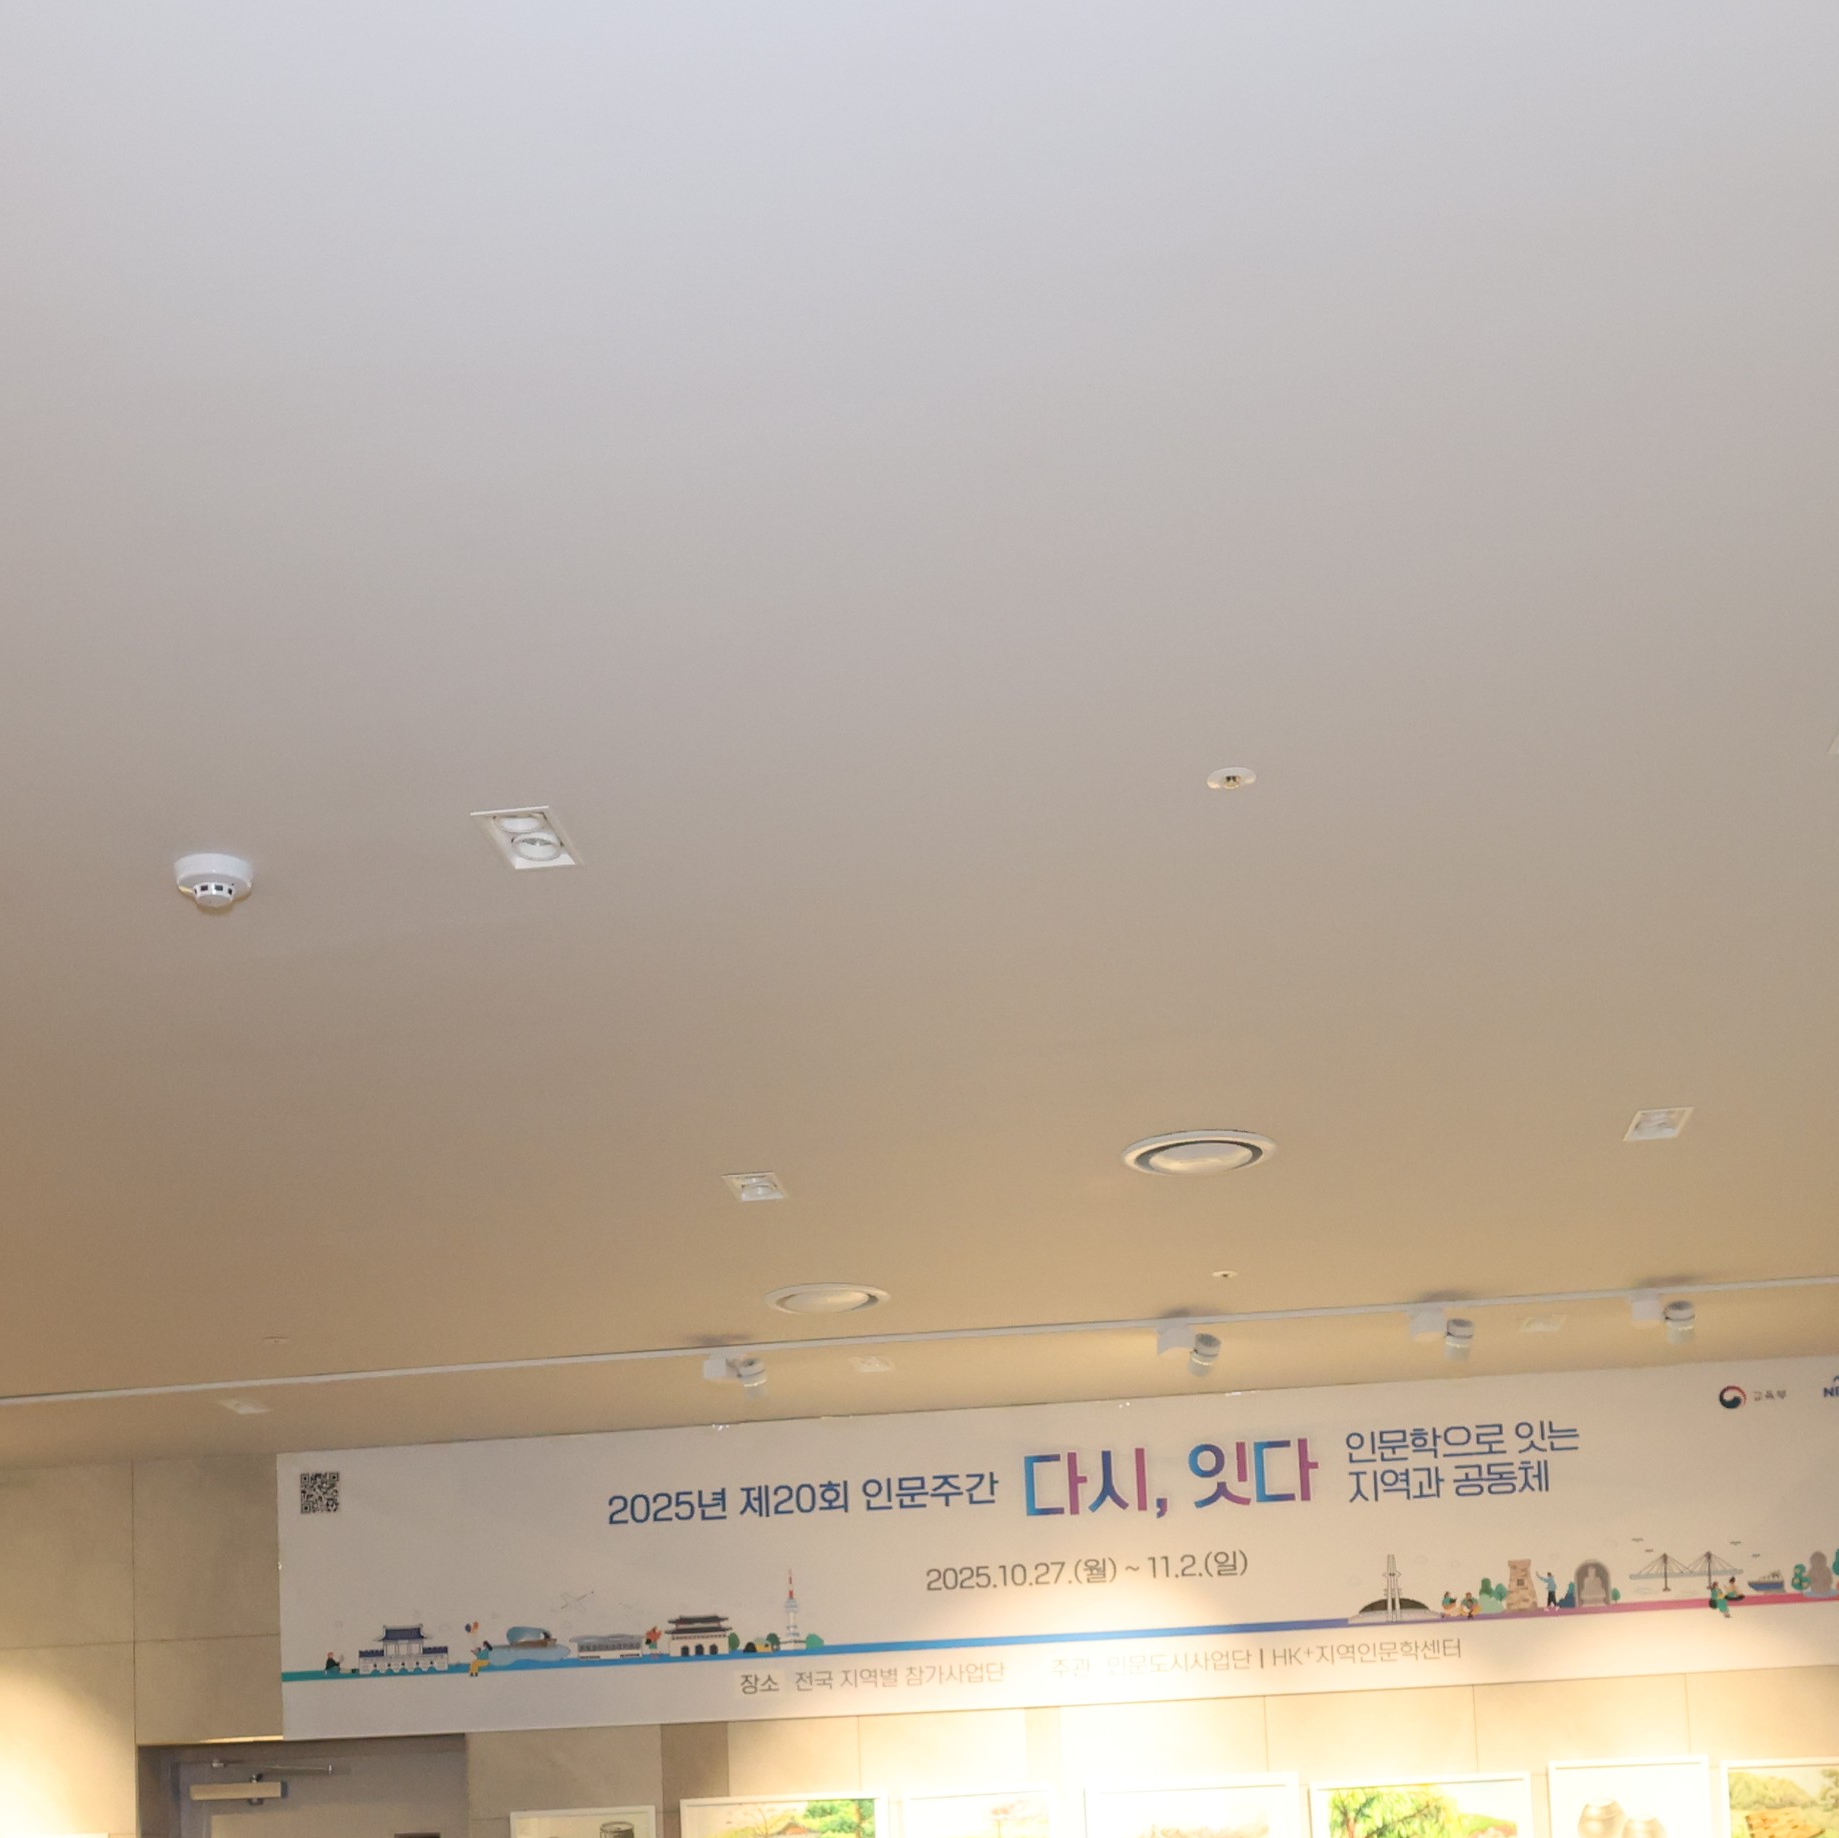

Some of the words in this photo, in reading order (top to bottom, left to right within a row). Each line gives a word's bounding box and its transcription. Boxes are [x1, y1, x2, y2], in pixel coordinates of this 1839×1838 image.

[1346, 1422, 1508, 1465] 인문학으로
[1515, 1420, 1580, 1454] 잇는
[608, 1487, 728, 1525] 2025년
[739, 1479, 850, 1518] 제20회
[862, 1472, 999, 1512] 인문주간
[1023, 1447, 1169, 1520] 다시,
[1187, 1438, 1320, 1510] 잇다
[1348, 1465, 1446, 1504] 지역과
[1452, 1459, 1551, 1498] 공동체
[926, 1557, 1118, 1592] 2025.10.27.(월)
[1148, 1549, 1249, 1580] 11.2.(일)
[739, 1672, 781, 1696] 장소
[794, 1670, 835, 1693] 전국
[840, 1666, 899, 1691] 지역별
[905, 1661, 1006, 1688] 참가사업단
